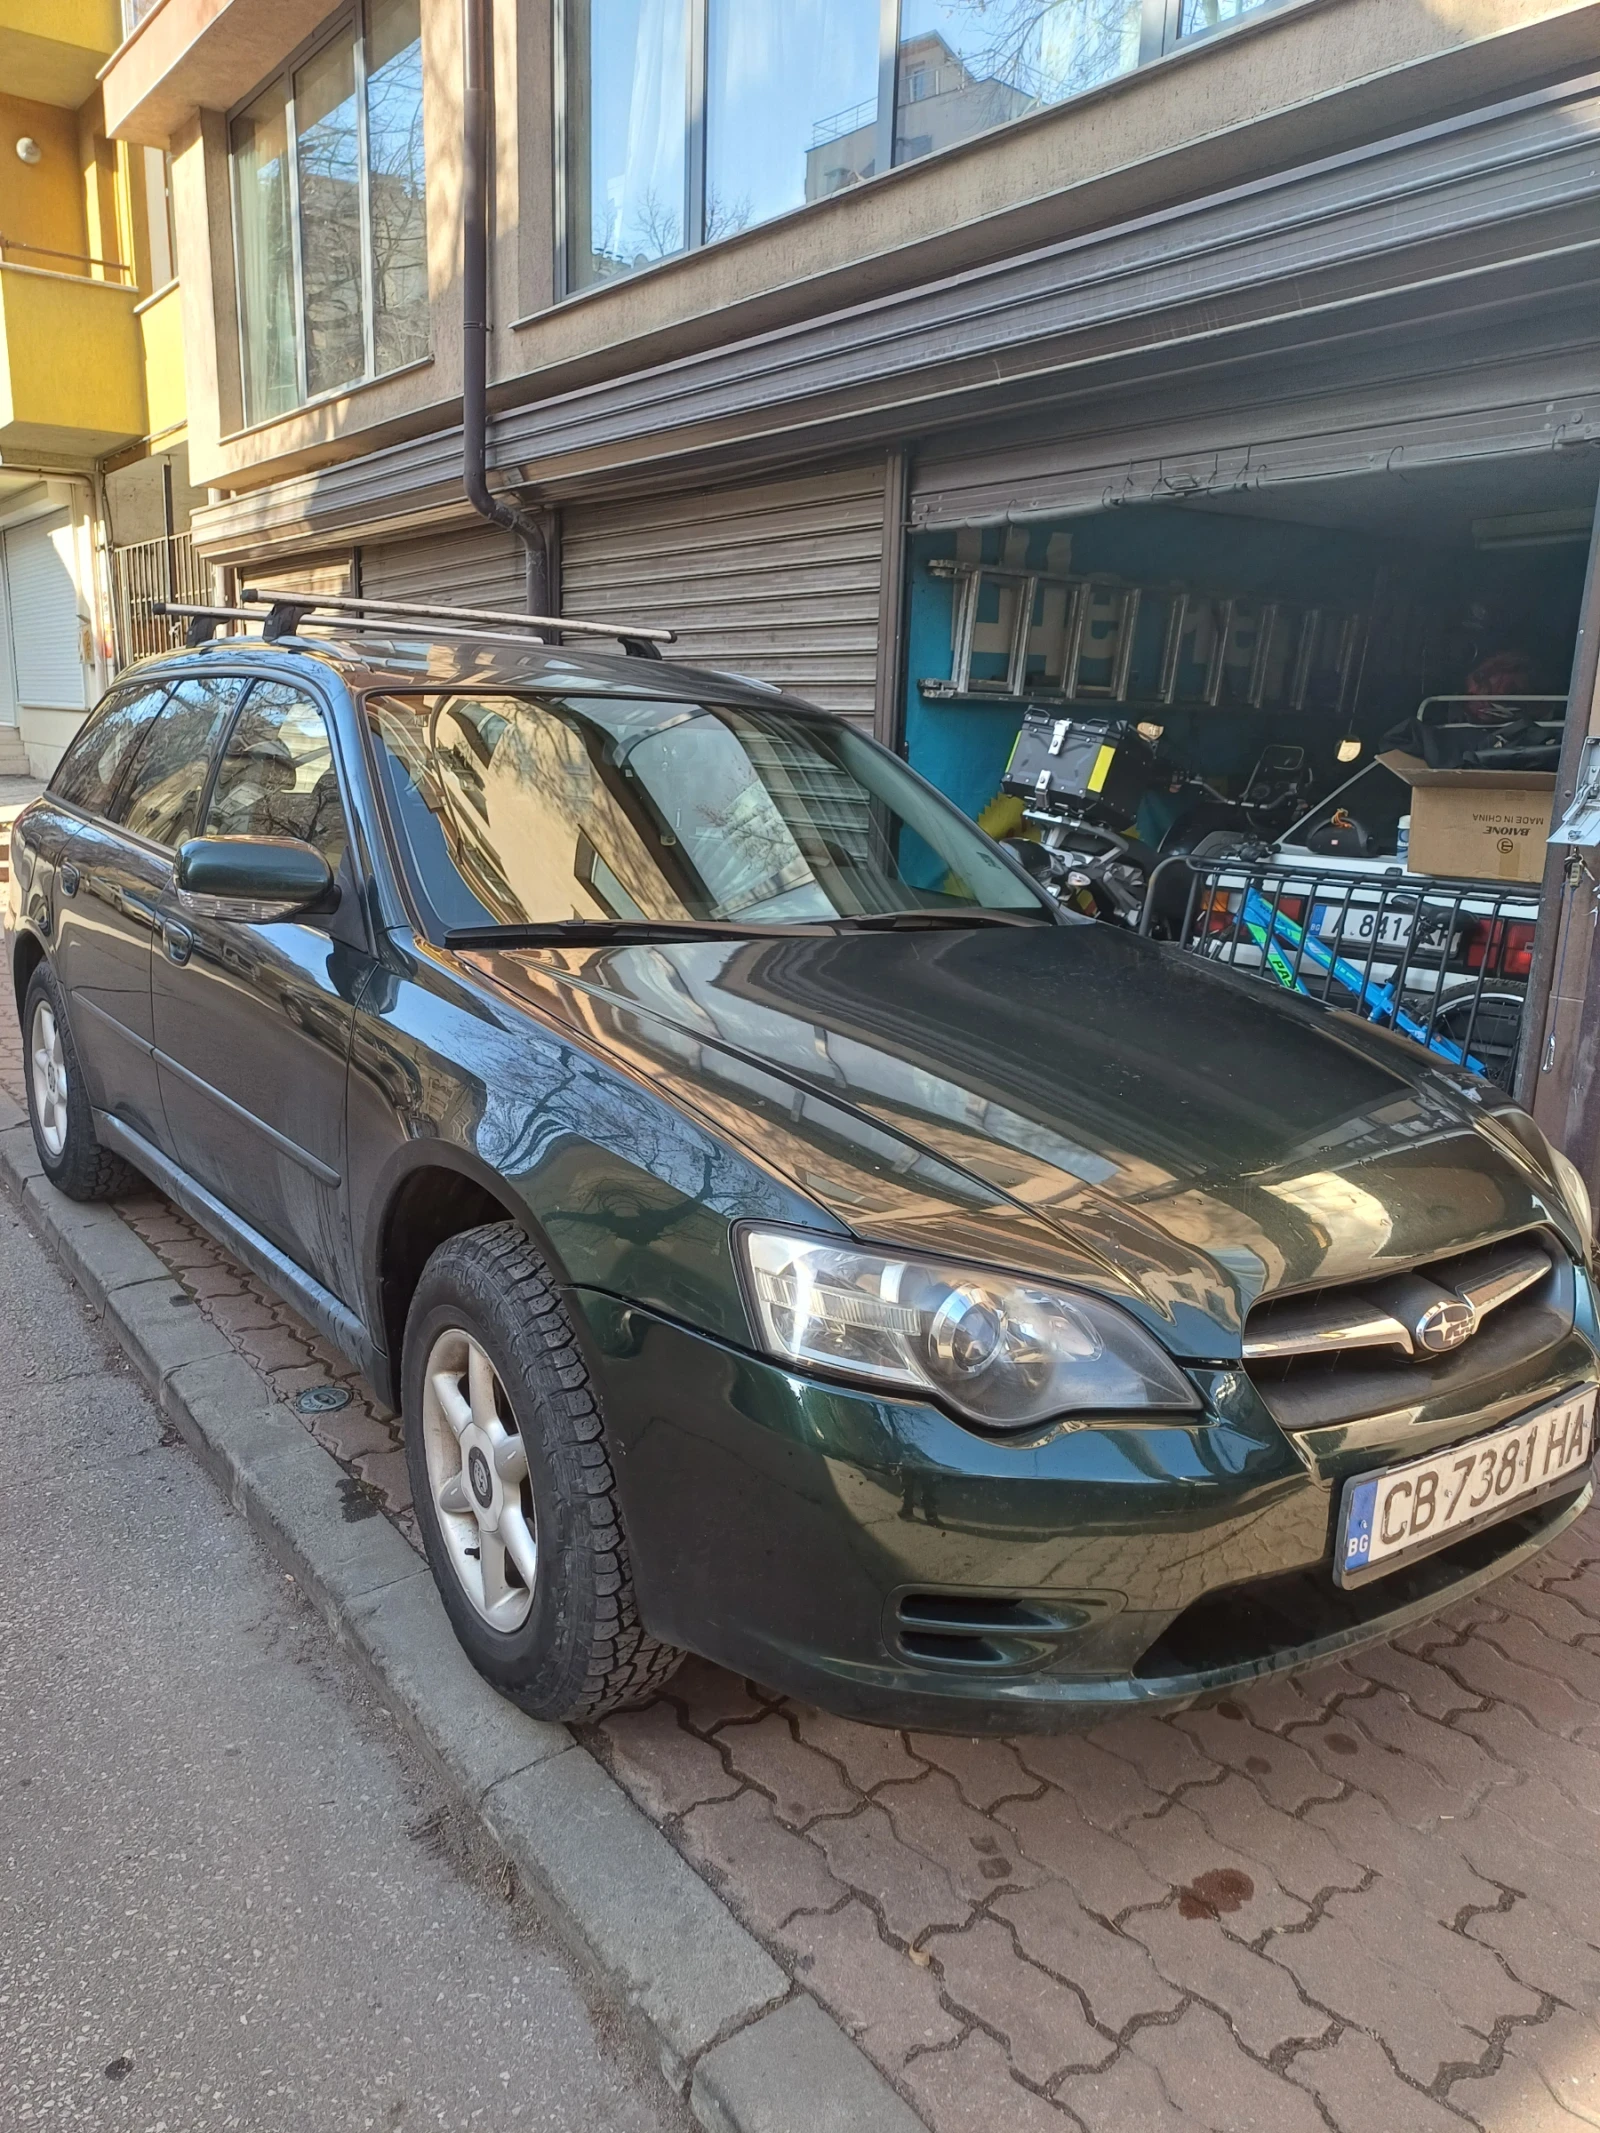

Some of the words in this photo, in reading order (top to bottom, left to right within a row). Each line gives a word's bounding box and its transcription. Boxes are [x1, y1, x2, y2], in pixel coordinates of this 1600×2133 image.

[1472, 813, 1502, 823] CHINA
[1503, 815, 1514, 824] IN
[1515, 816, 1544, 825] MADE
[1482, 826, 1531, 836] BAIONE
[1310, 923, 1321, 932] BG
[1359, 914, 1416, 942] 8414
[1379, 1470, 1439, 1545] CB
[1444, 1425, 1538, 1521] 7381
[1543, 1404, 1584, 1476] HA
[1348, 1534, 1369, 1557] BG
